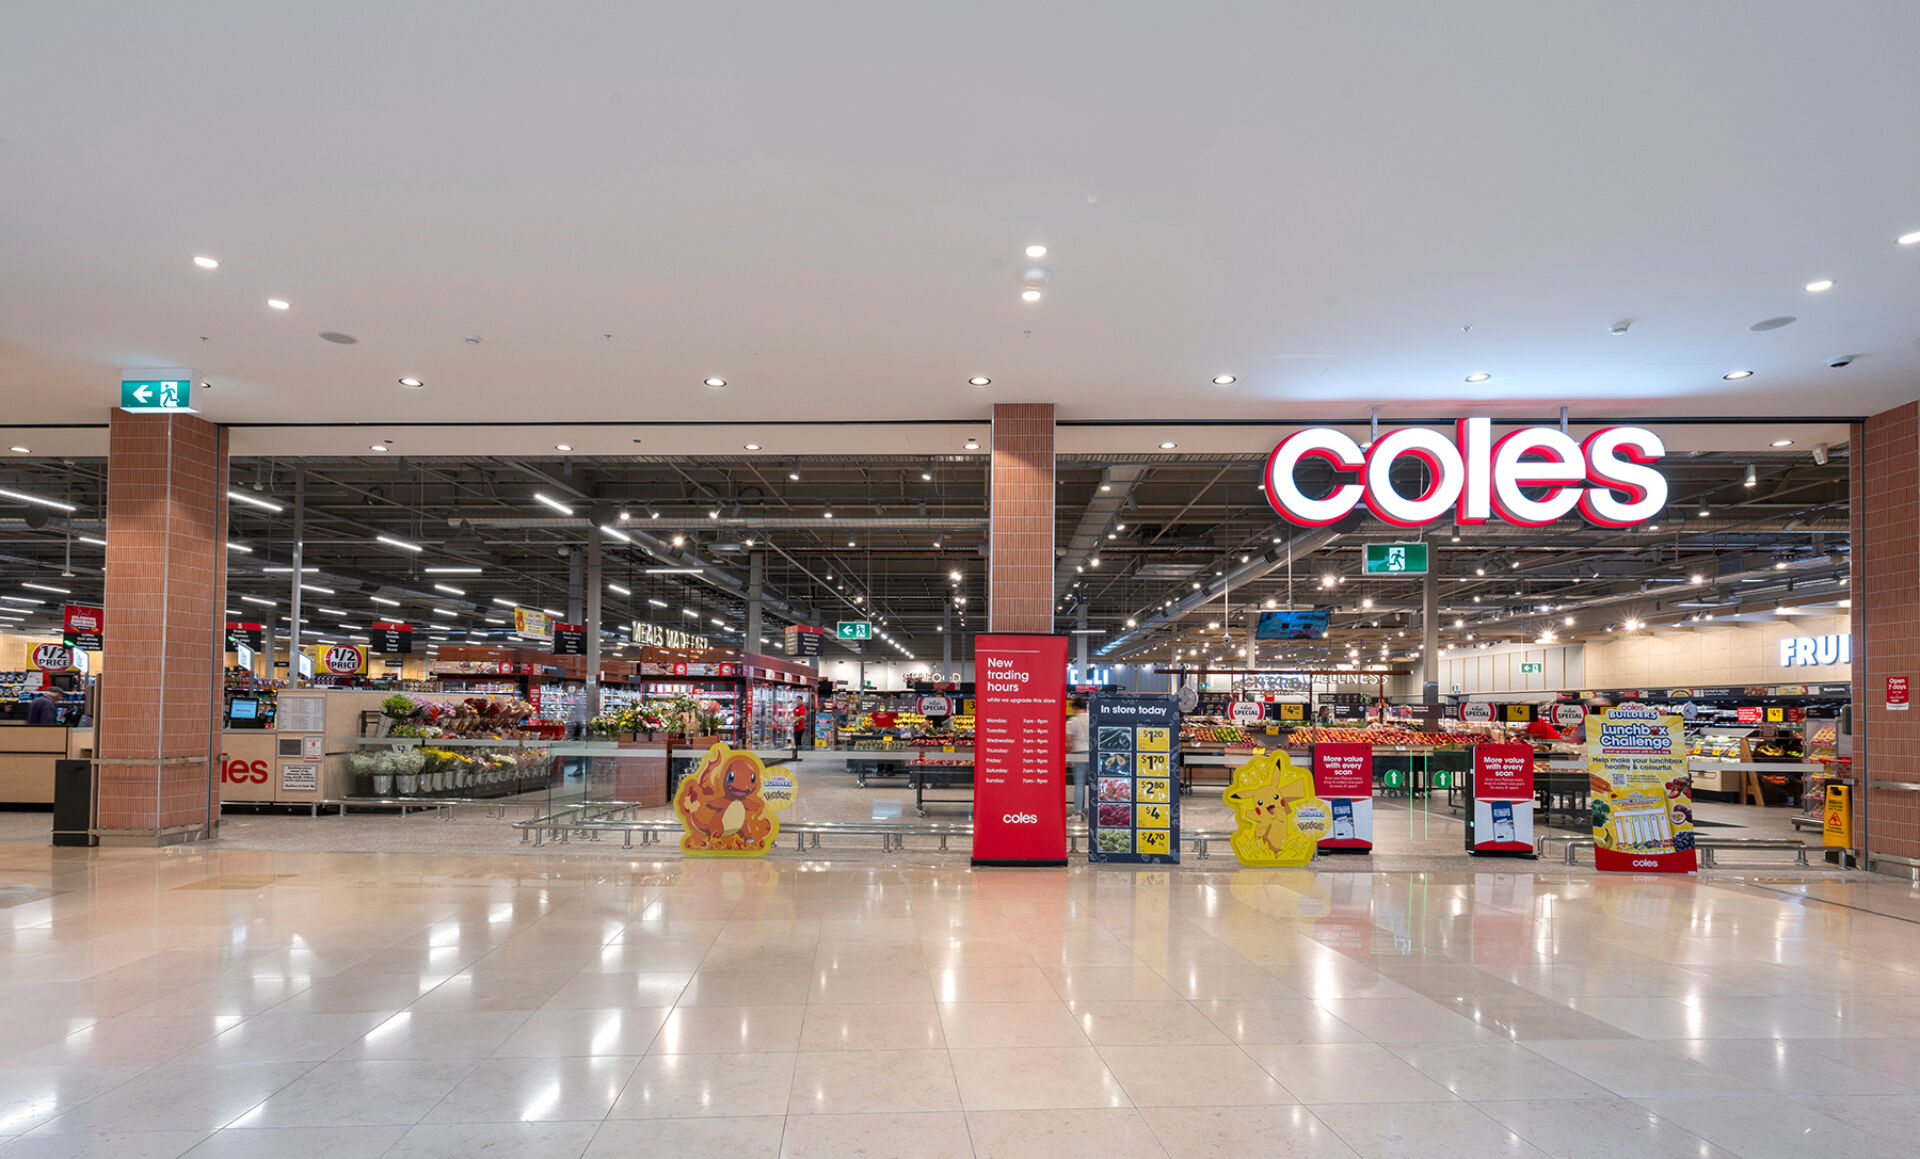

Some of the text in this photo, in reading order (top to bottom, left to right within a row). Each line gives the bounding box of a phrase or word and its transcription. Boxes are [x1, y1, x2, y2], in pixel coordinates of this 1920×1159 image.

[1265, 417, 1668, 528] coles
[41, 645, 67, 659] 1/2
[333, 648, 356, 661] 1/2
[987, 658, 1013, 668] New
[987, 670, 1029, 683] trading
[987, 682, 1019, 692] hours
[1100, 705, 1167, 716] In store today
[1620, 703, 1644, 711] coles
[1608, 710, 1658, 720] BUILDERS
[1600, 735, 1672, 750] Challenge
[1504, 756, 1525, 764] value
[1592, 756, 1606, 764] Help
[1003, 812, 1038, 824] coles
[1633, 859, 1658, 868] coles
